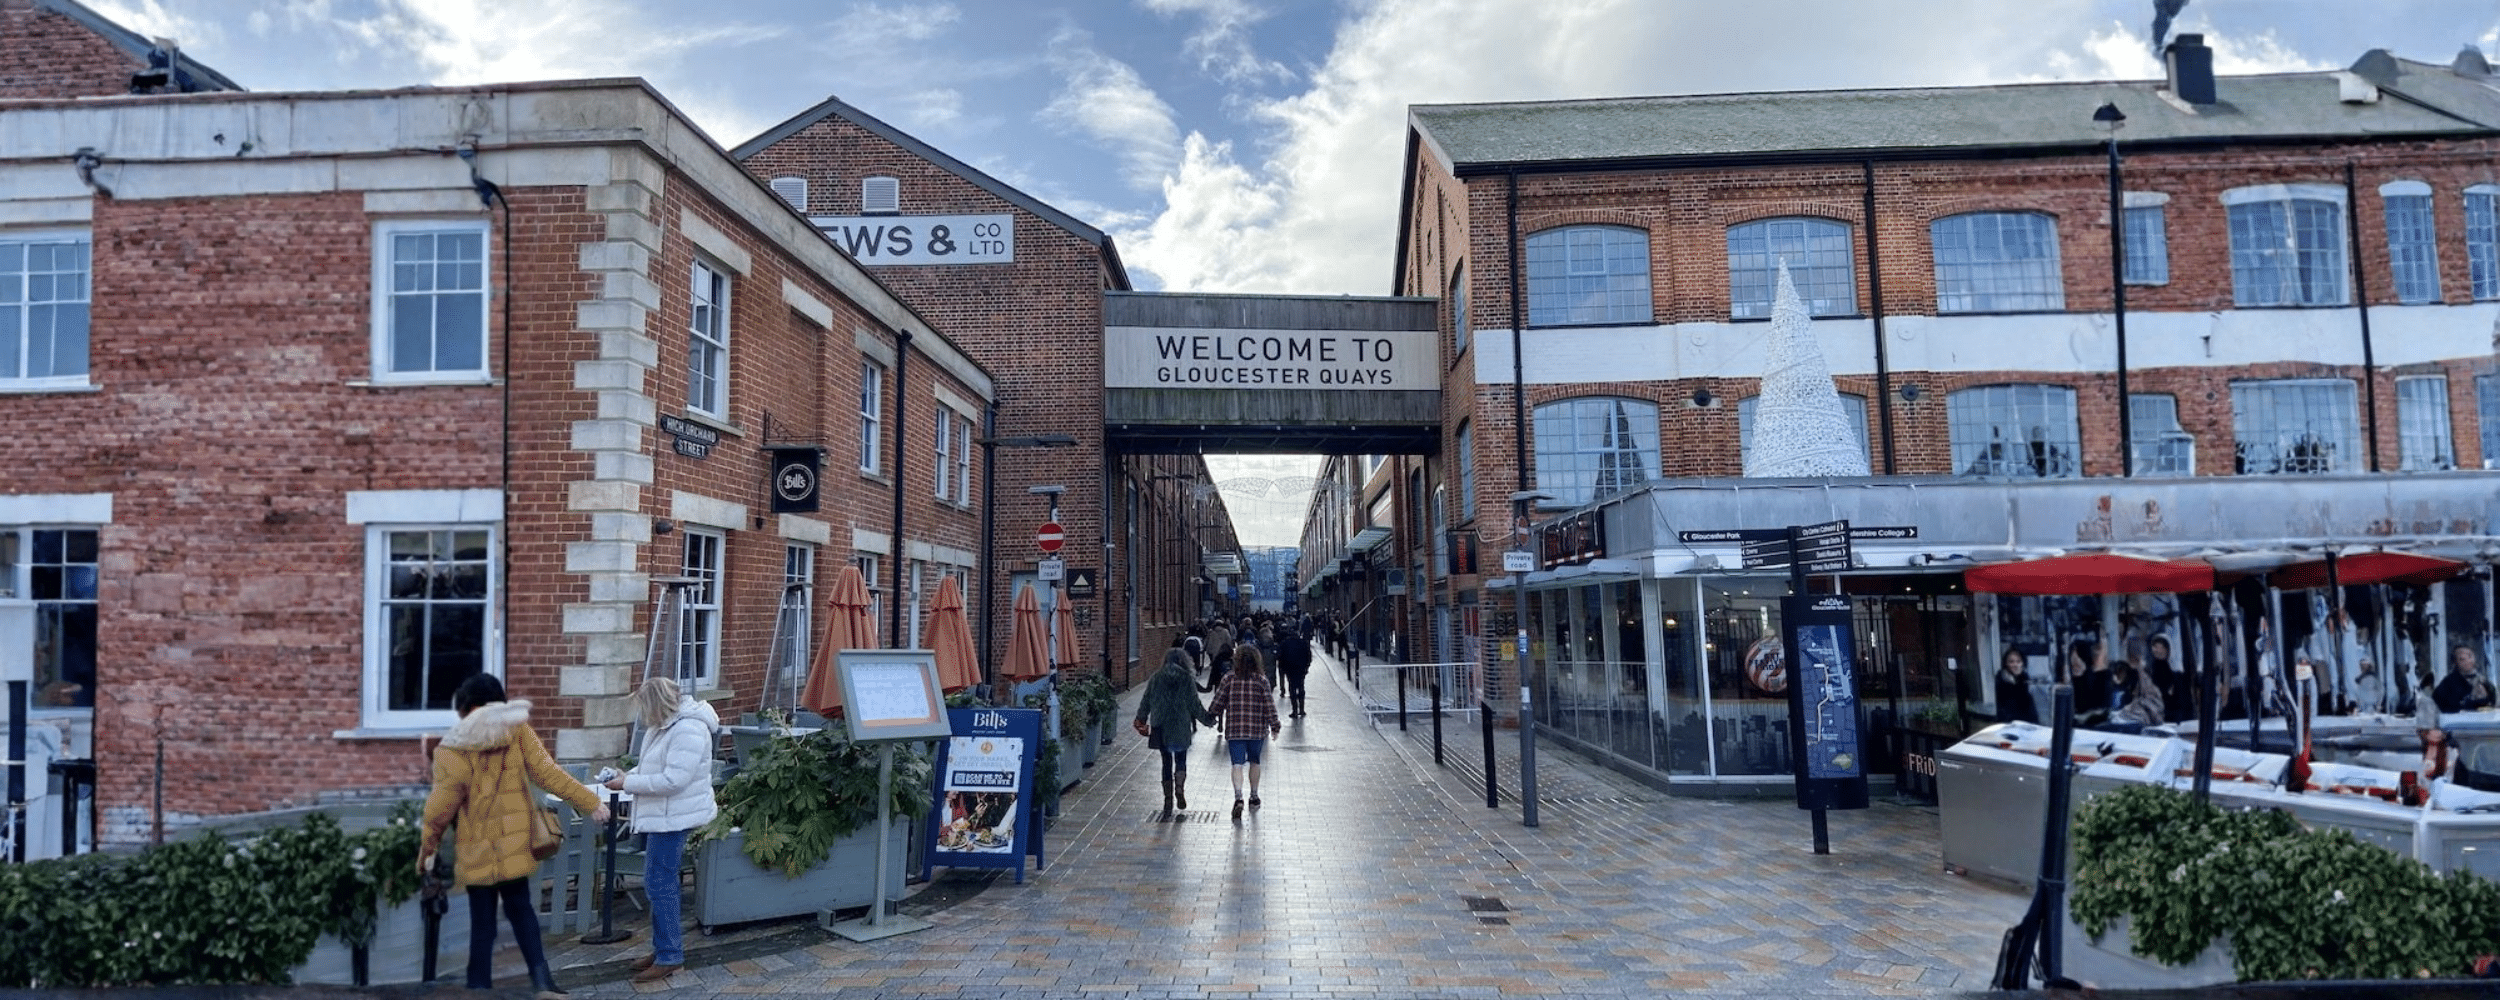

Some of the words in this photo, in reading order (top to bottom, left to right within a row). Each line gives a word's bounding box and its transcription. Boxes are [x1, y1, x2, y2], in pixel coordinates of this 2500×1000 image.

[974, 223, 1002, 238] CO
[927, 224, 957, 256] &
[969, 240, 1006, 256] LTD
[1156, 335, 1337, 362] WELCOME
[1352, 338, 1394, 362] TO
[1157, 366, 1310, 385] GLOUCESTER
[1319, 368, 1393, 385] QUAYS
[667, 417, 684, 433] HIGH
[686, 422, 717, 444] ORCHARD
[678, 440, 706, 457] STREET
[784, 473, 806, 489] Bill's
[1691, 532, 1726, 540] Gloucester
[1878, 529, 1905, 538] College
[973, 710, 1008, 729] Bill's
